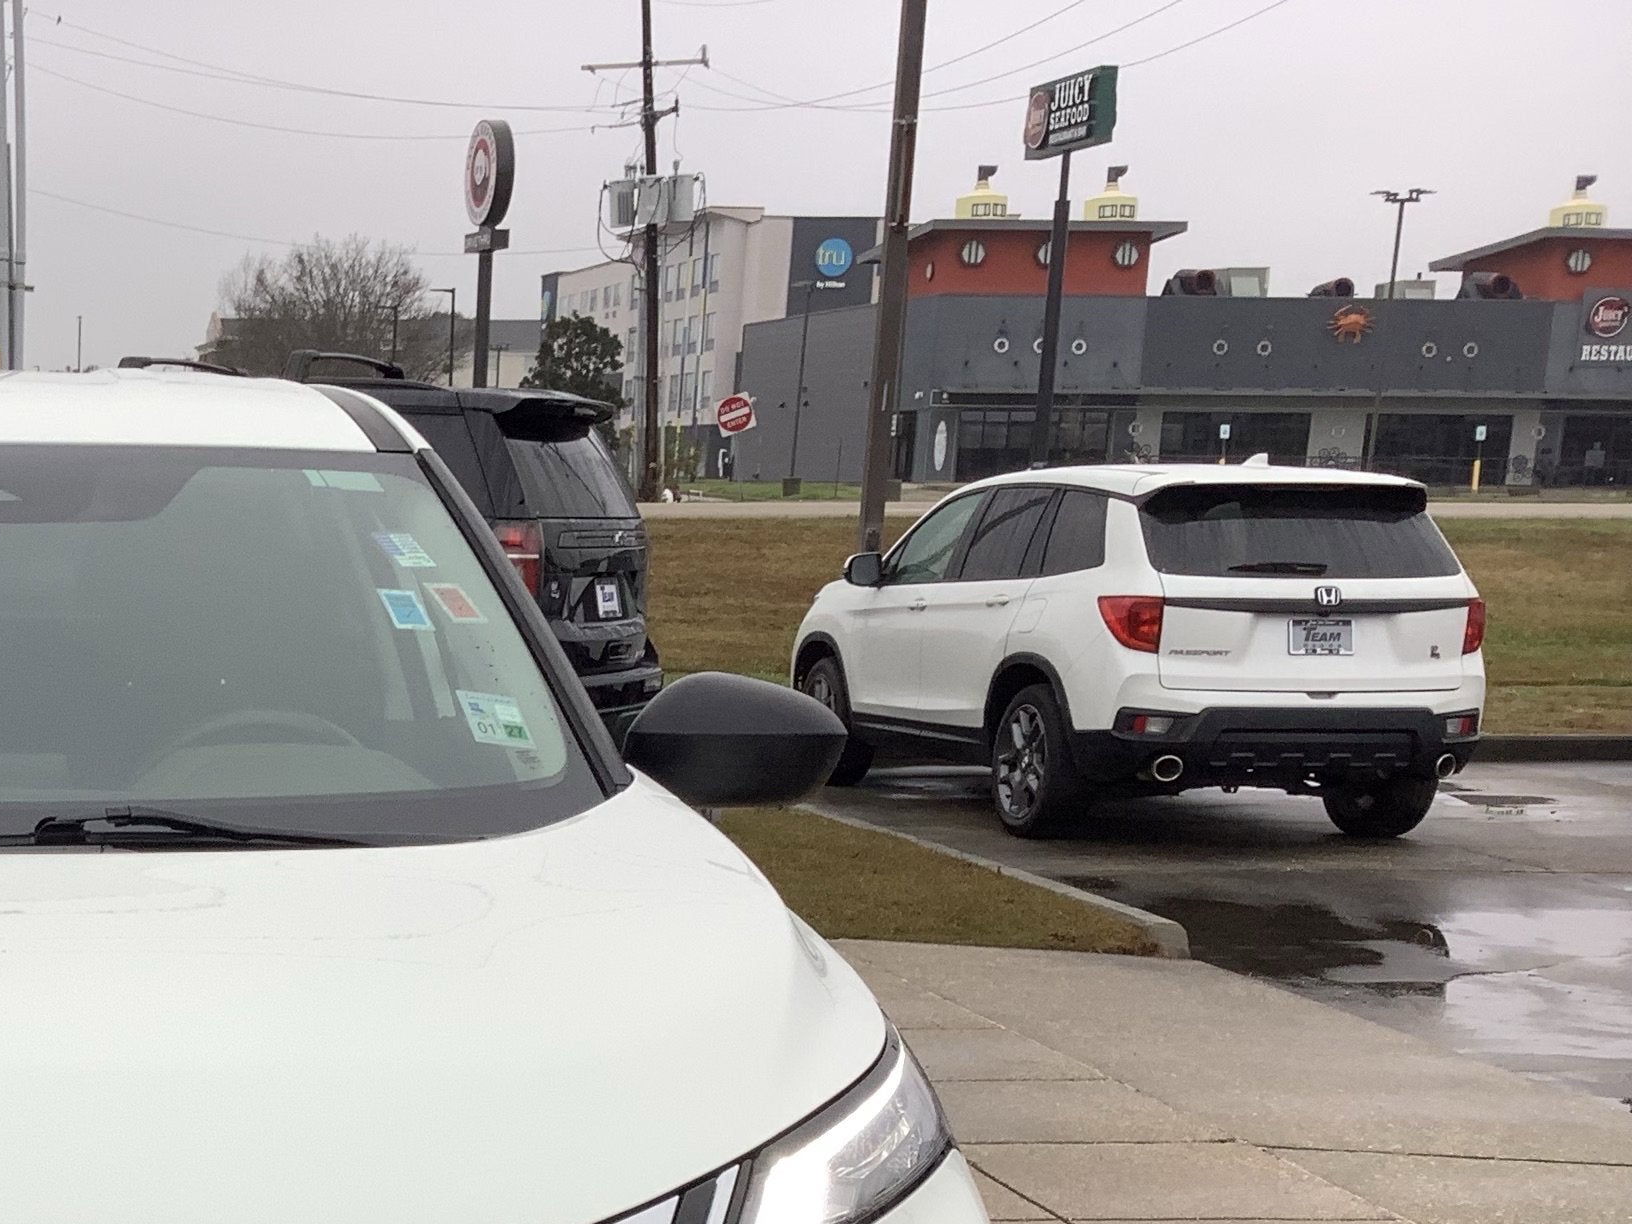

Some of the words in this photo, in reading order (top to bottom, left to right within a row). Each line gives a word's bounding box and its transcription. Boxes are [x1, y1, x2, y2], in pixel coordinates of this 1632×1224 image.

[1050, 74, 1092, 111] JUICY
[1049, 104, 1090, 130] SEAFOOD
[727, 416, 747, 428] ENTER
[1303, 626, 1341, 641] TEAM
